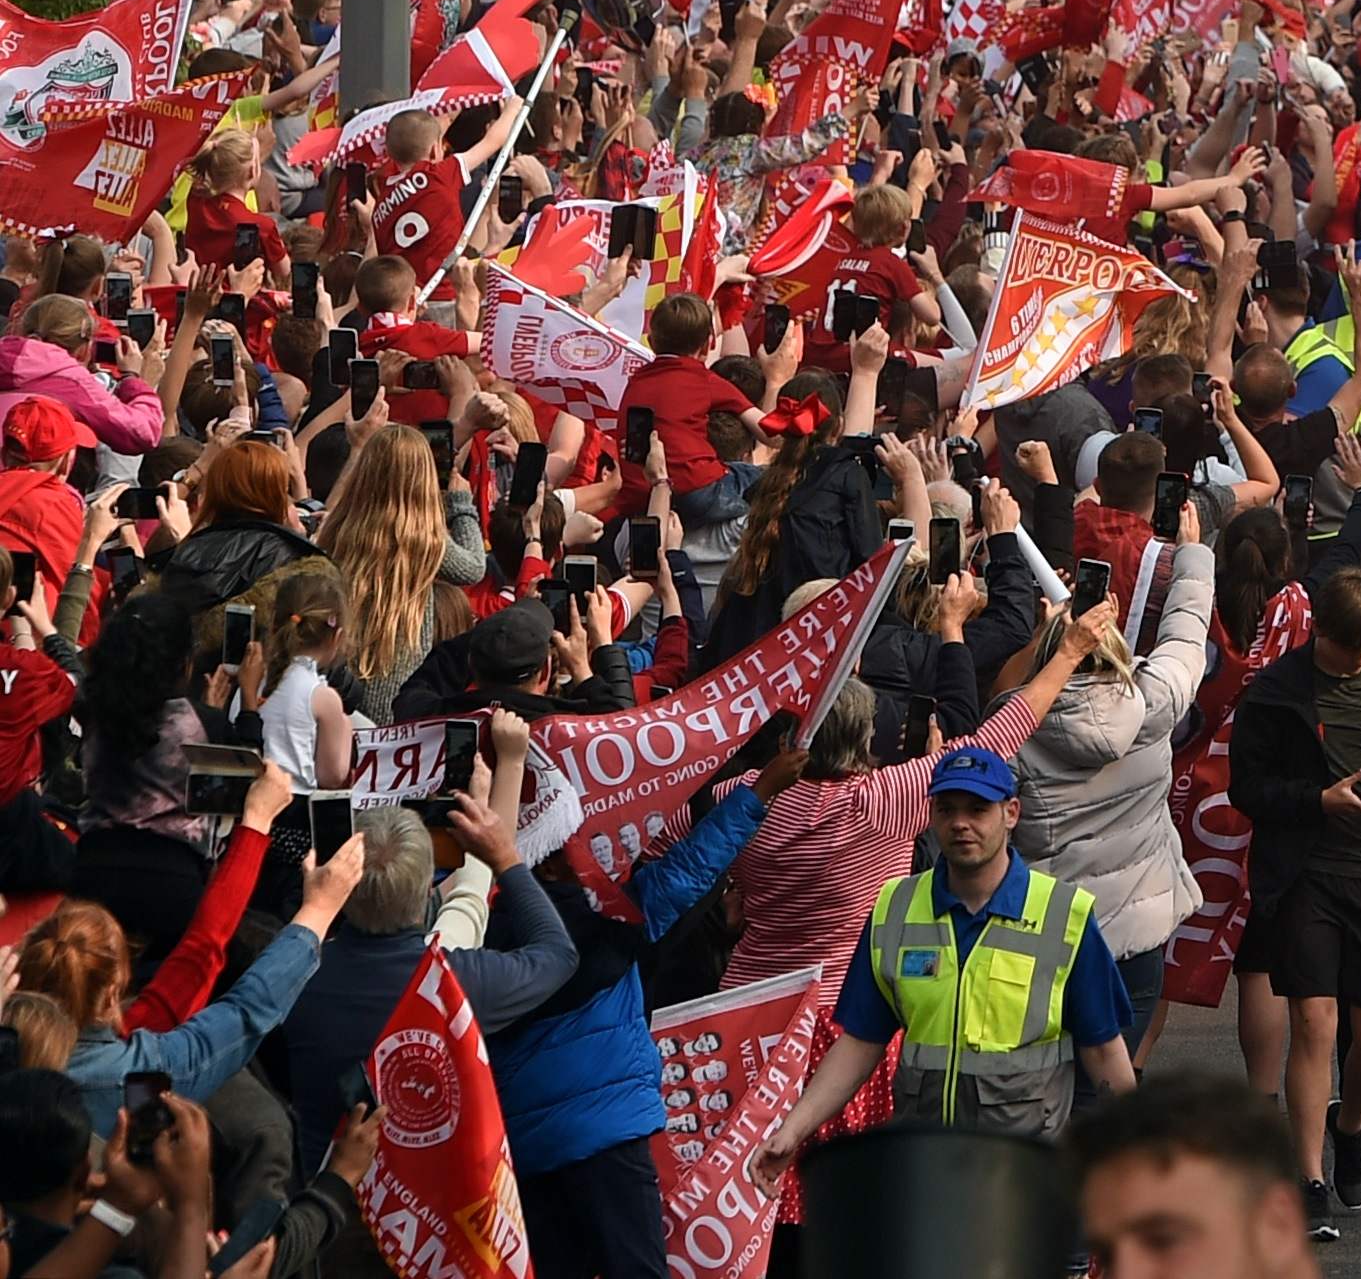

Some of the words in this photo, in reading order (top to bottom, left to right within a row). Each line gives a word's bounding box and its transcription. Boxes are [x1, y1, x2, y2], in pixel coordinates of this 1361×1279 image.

[372, 171, 429, 229] FIRMINO
[740, 1038, 760, 1087] WE'R
[383, 1171, 447, 1238] ENGLAND
